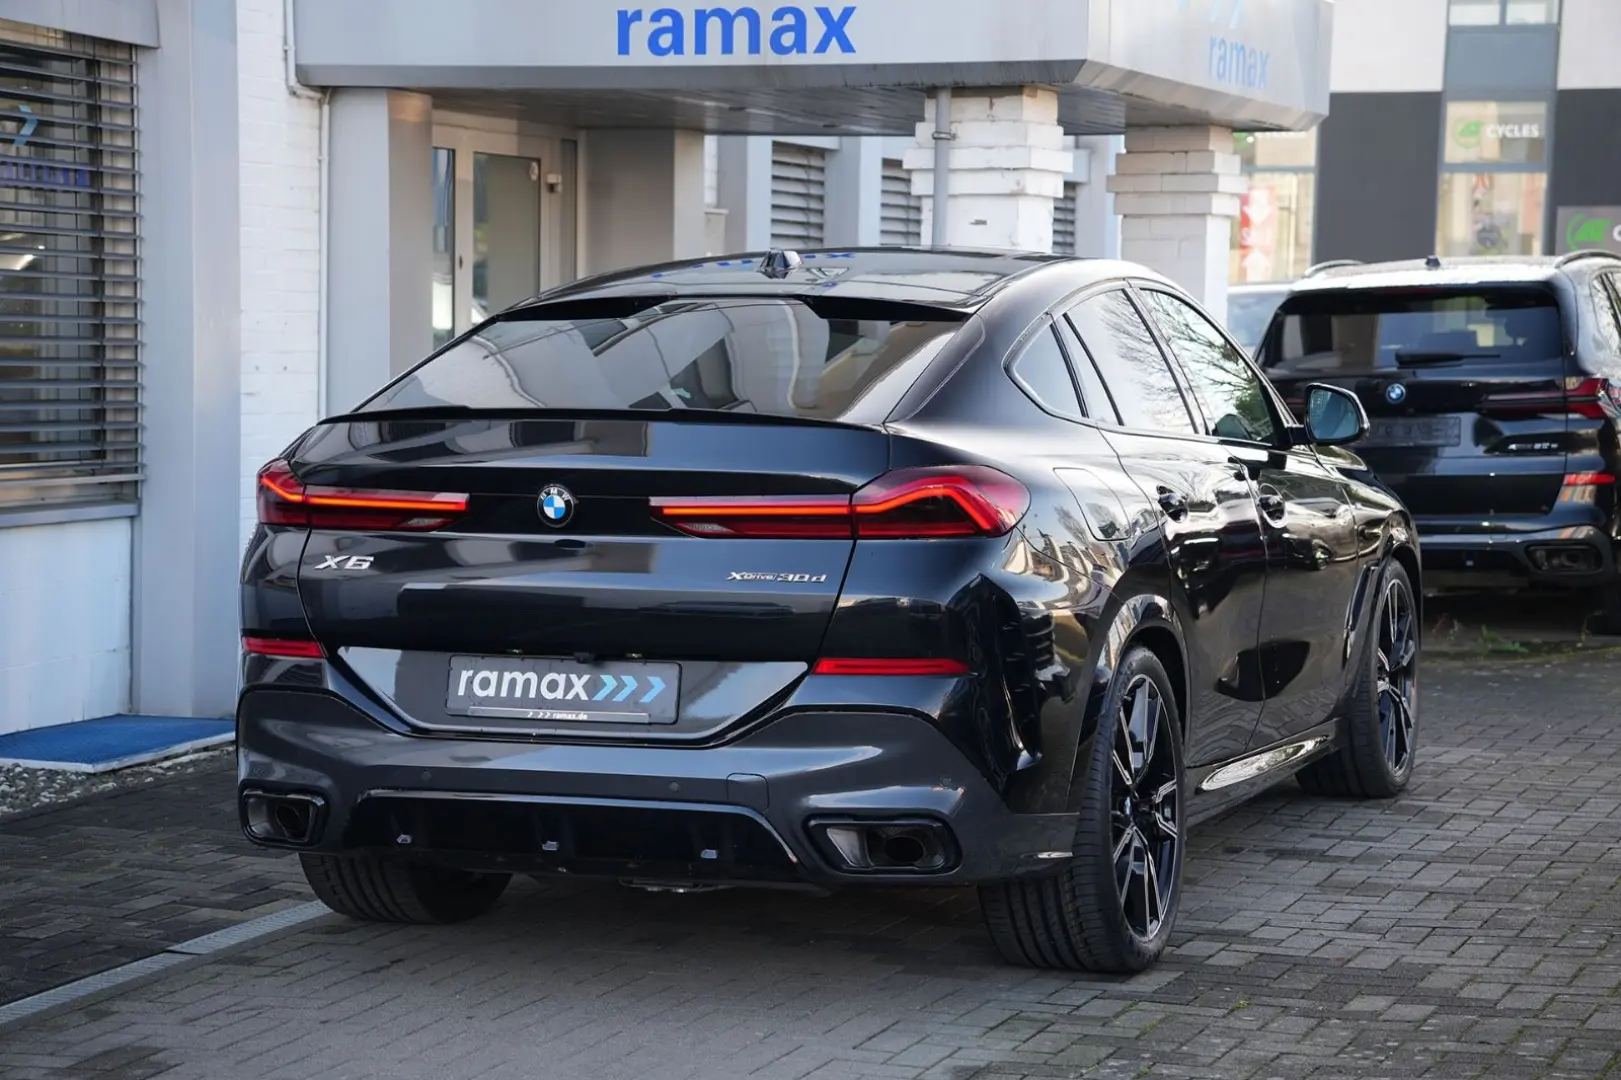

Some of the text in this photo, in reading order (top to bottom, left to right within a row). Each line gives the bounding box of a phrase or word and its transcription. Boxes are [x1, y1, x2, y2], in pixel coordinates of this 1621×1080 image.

[617, 6, 857, 56] ramax
[1208, 35, 1270, 90] ramax
[1486, 123, 1540, 138] CYCLES
[314, 555, 375, 570] X6
[458, 669, 592, 701] ramax
